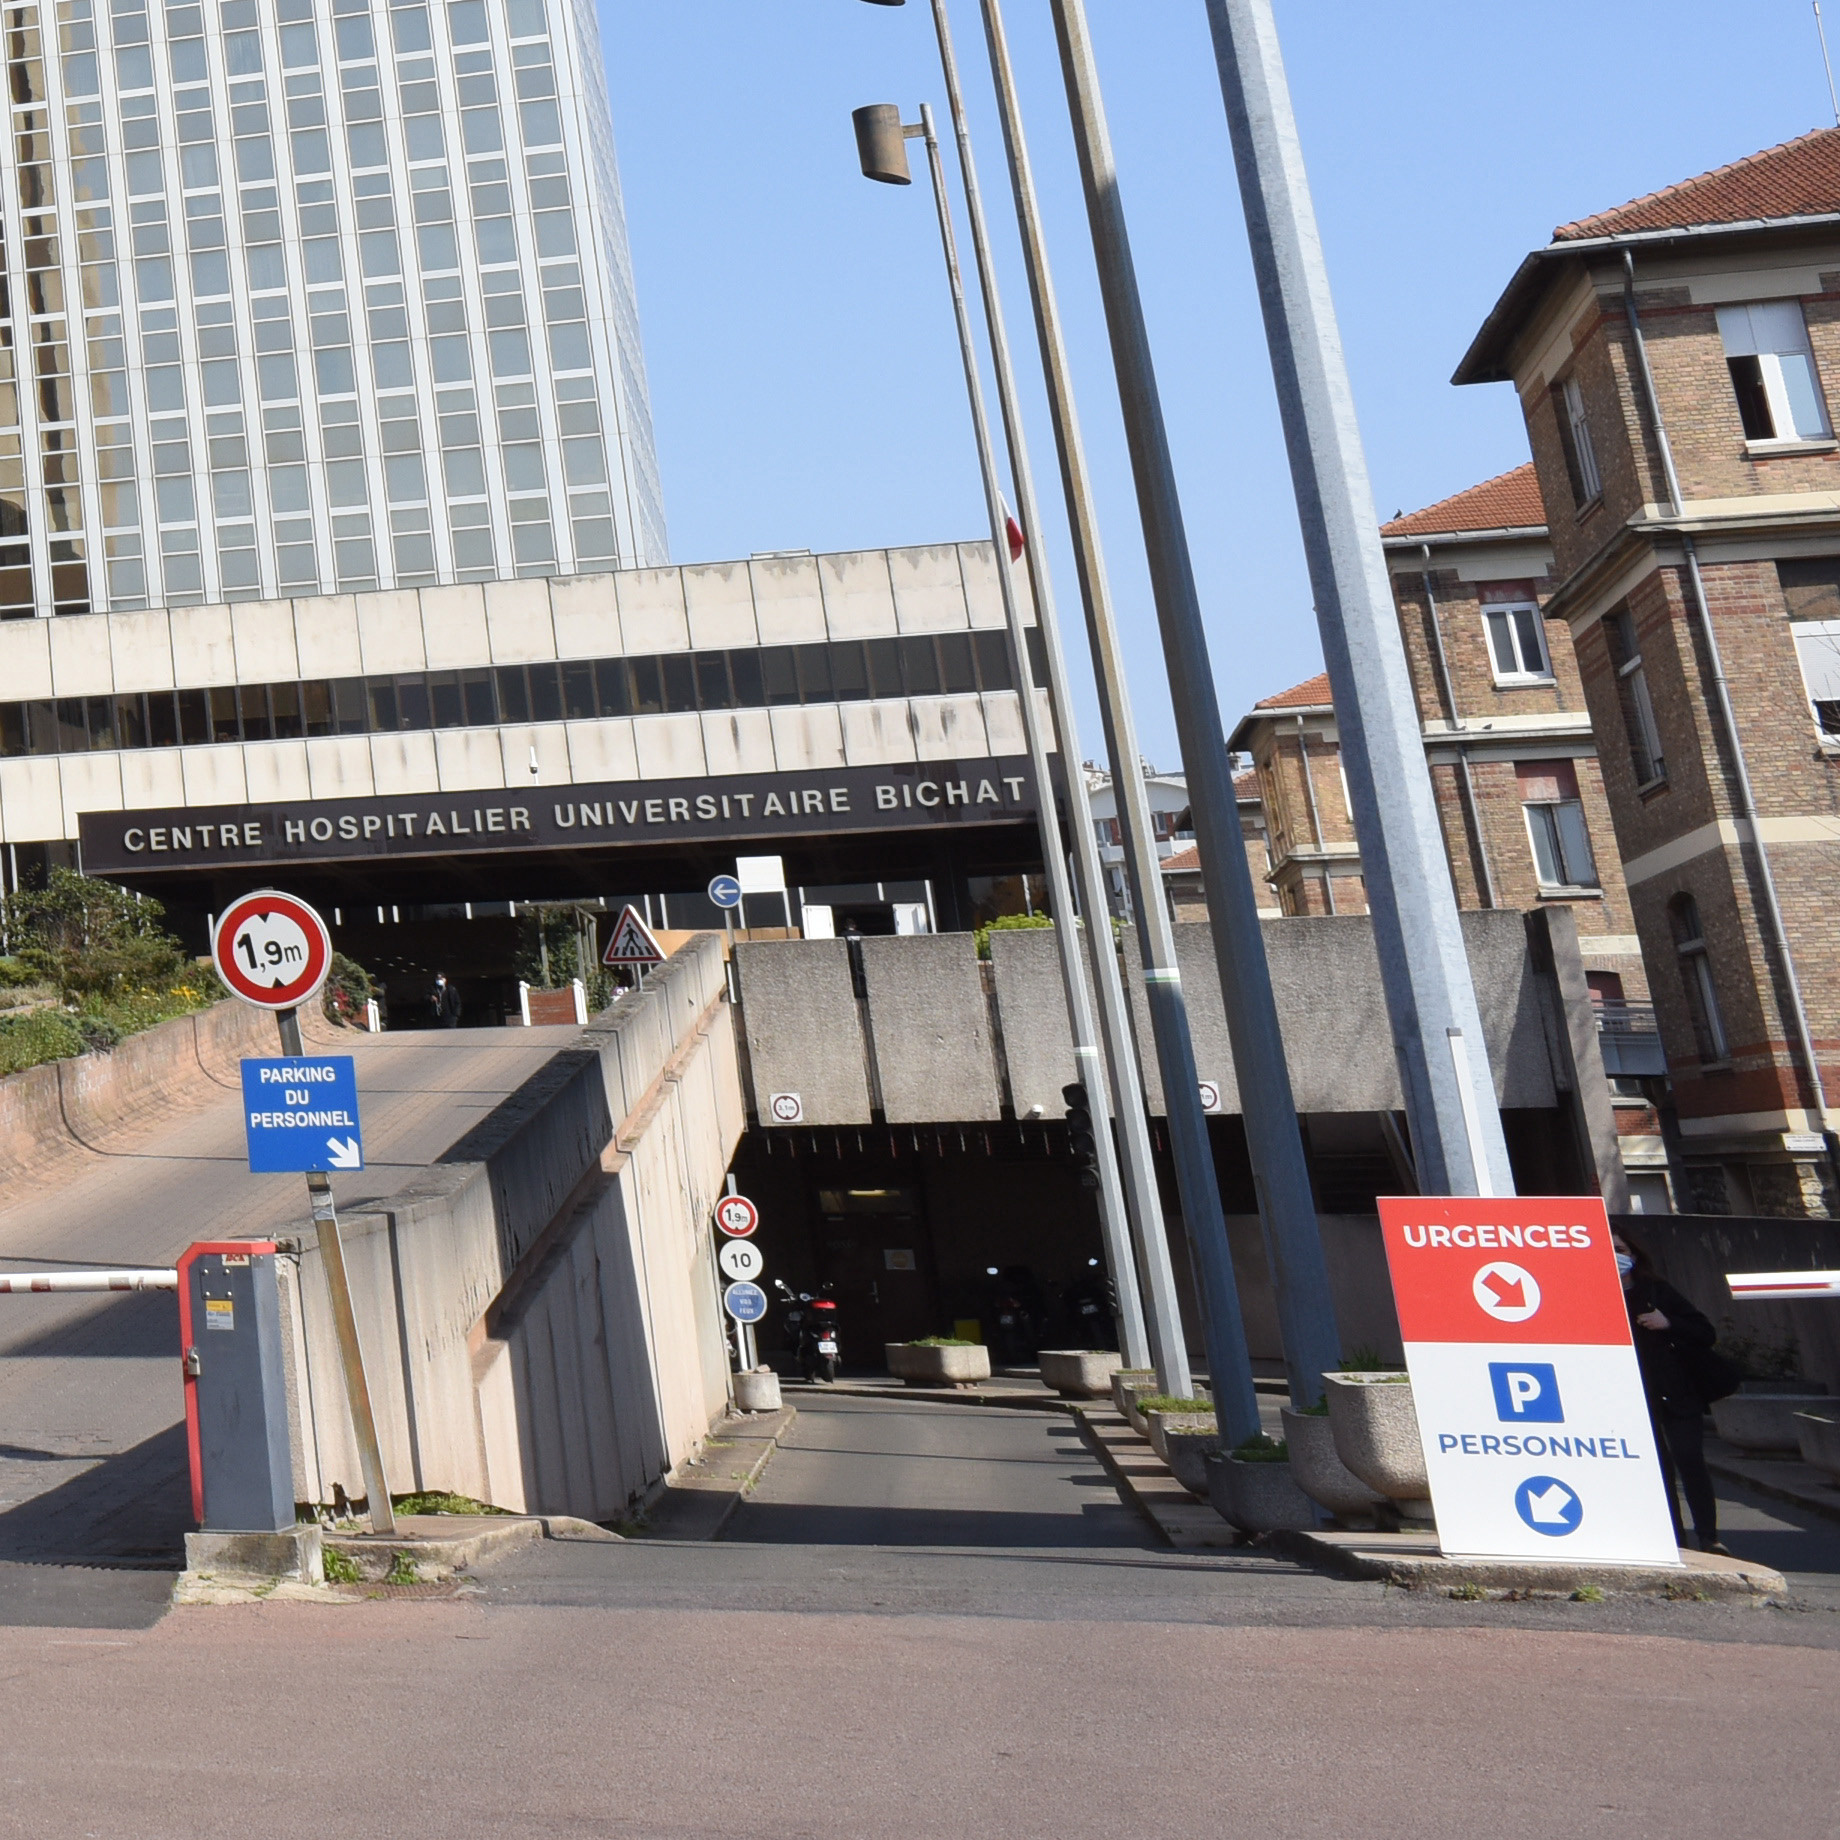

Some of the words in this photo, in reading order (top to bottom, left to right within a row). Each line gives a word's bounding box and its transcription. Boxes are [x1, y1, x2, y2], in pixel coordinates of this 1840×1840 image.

[123, 821, 263, 852] CENTRE
[284, 806, 531, 844] HOSPITALIER
[554, 787, 852, 828] UNIVERSITAIRE
[875, 776, 1026, 810] BICHAT
[237, 932, 303, 973] 1,9m
[260, 1066, 336, 1083] PARKING
[285, 1089, 310, 1105] DU
[250, 1110, 355, 1128] PERSONNEL
[1403, 1224, 1592, 1249] URGENCES
[730, 1252, 752, 1268] 10
[1506, 1372, 1542, 1413] P
[1437, 1433, 1640, 1459] PERSONNEL
